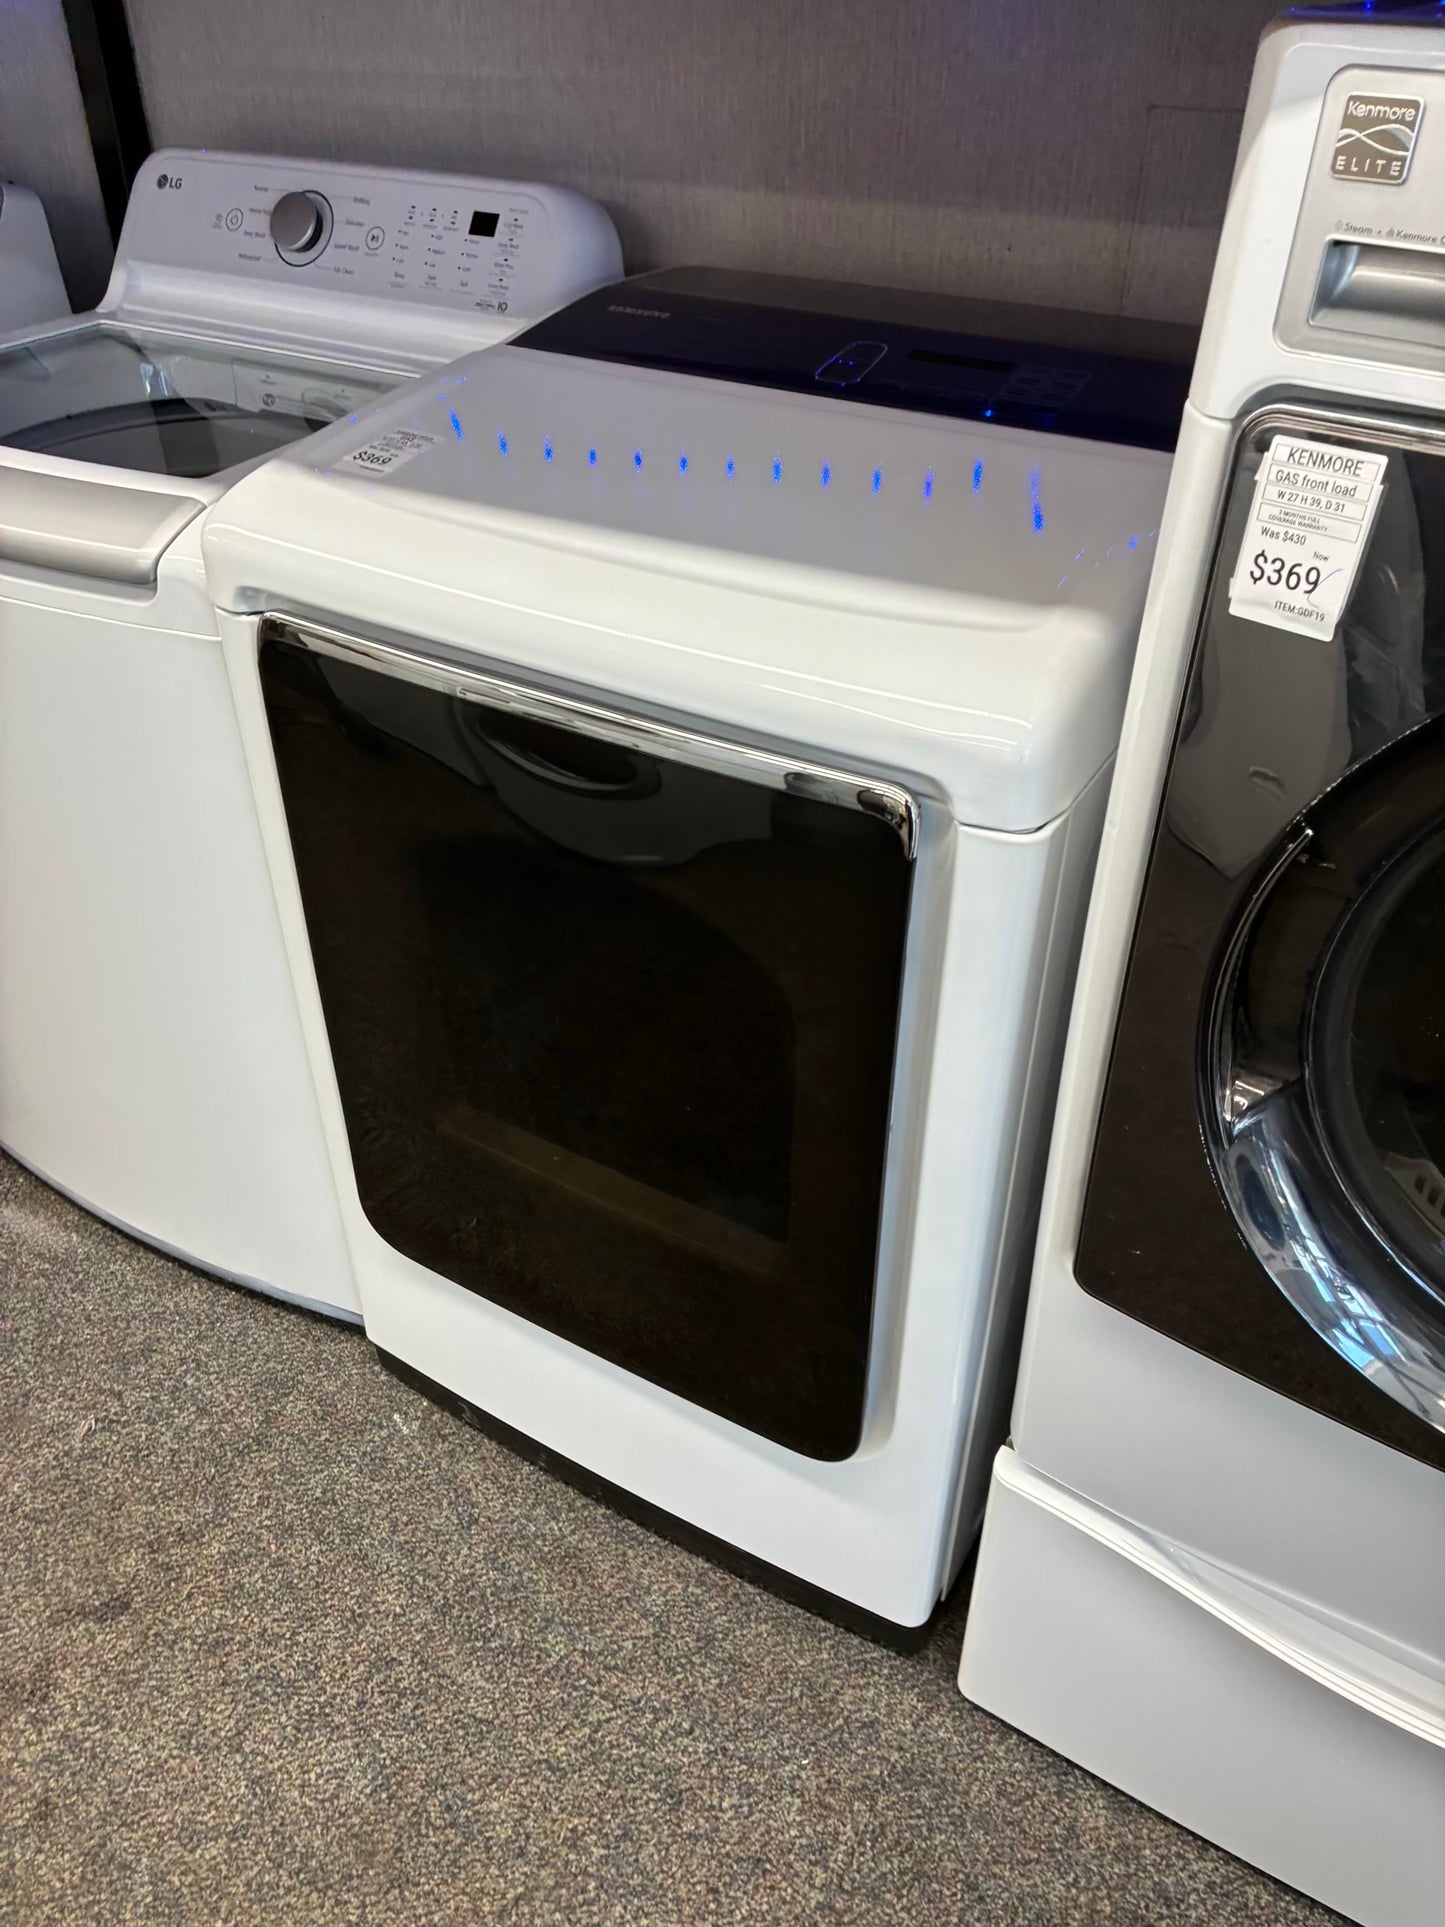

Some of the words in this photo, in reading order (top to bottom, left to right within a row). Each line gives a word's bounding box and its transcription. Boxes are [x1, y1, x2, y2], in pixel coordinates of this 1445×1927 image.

[1347, 101, 1416, 121] Kenmore
[1335, 156, 1402, 176] ELITE
[1344, 222, 1372, 234] Steam
[1395, 229, 1437, 244] Kenmore
[353, 451, 392, 466] $369
[1287, 447, 1364, 476] KENMORE
[1275, 469, 1299, 485] GAS
[1301, 474, 1328, 491] front
[1331, 481, 1358, 497] load
[1277, 490, 1286, 500] W
[1287, 492, 1299, 503] 27
[1300, 495, 1308, 505] H
[1325, 500, 1332, 510] D
[1334, 502, 1345, 513] 31
[1261, 526, 1280, 540] Was
[1282, 530, 1307, 546] $430
[1313, 551, 1330, 562] Now
[1250, 550, 1321, 594] $369
[1274, 600, 1325, 622] ITEM:GDF19
